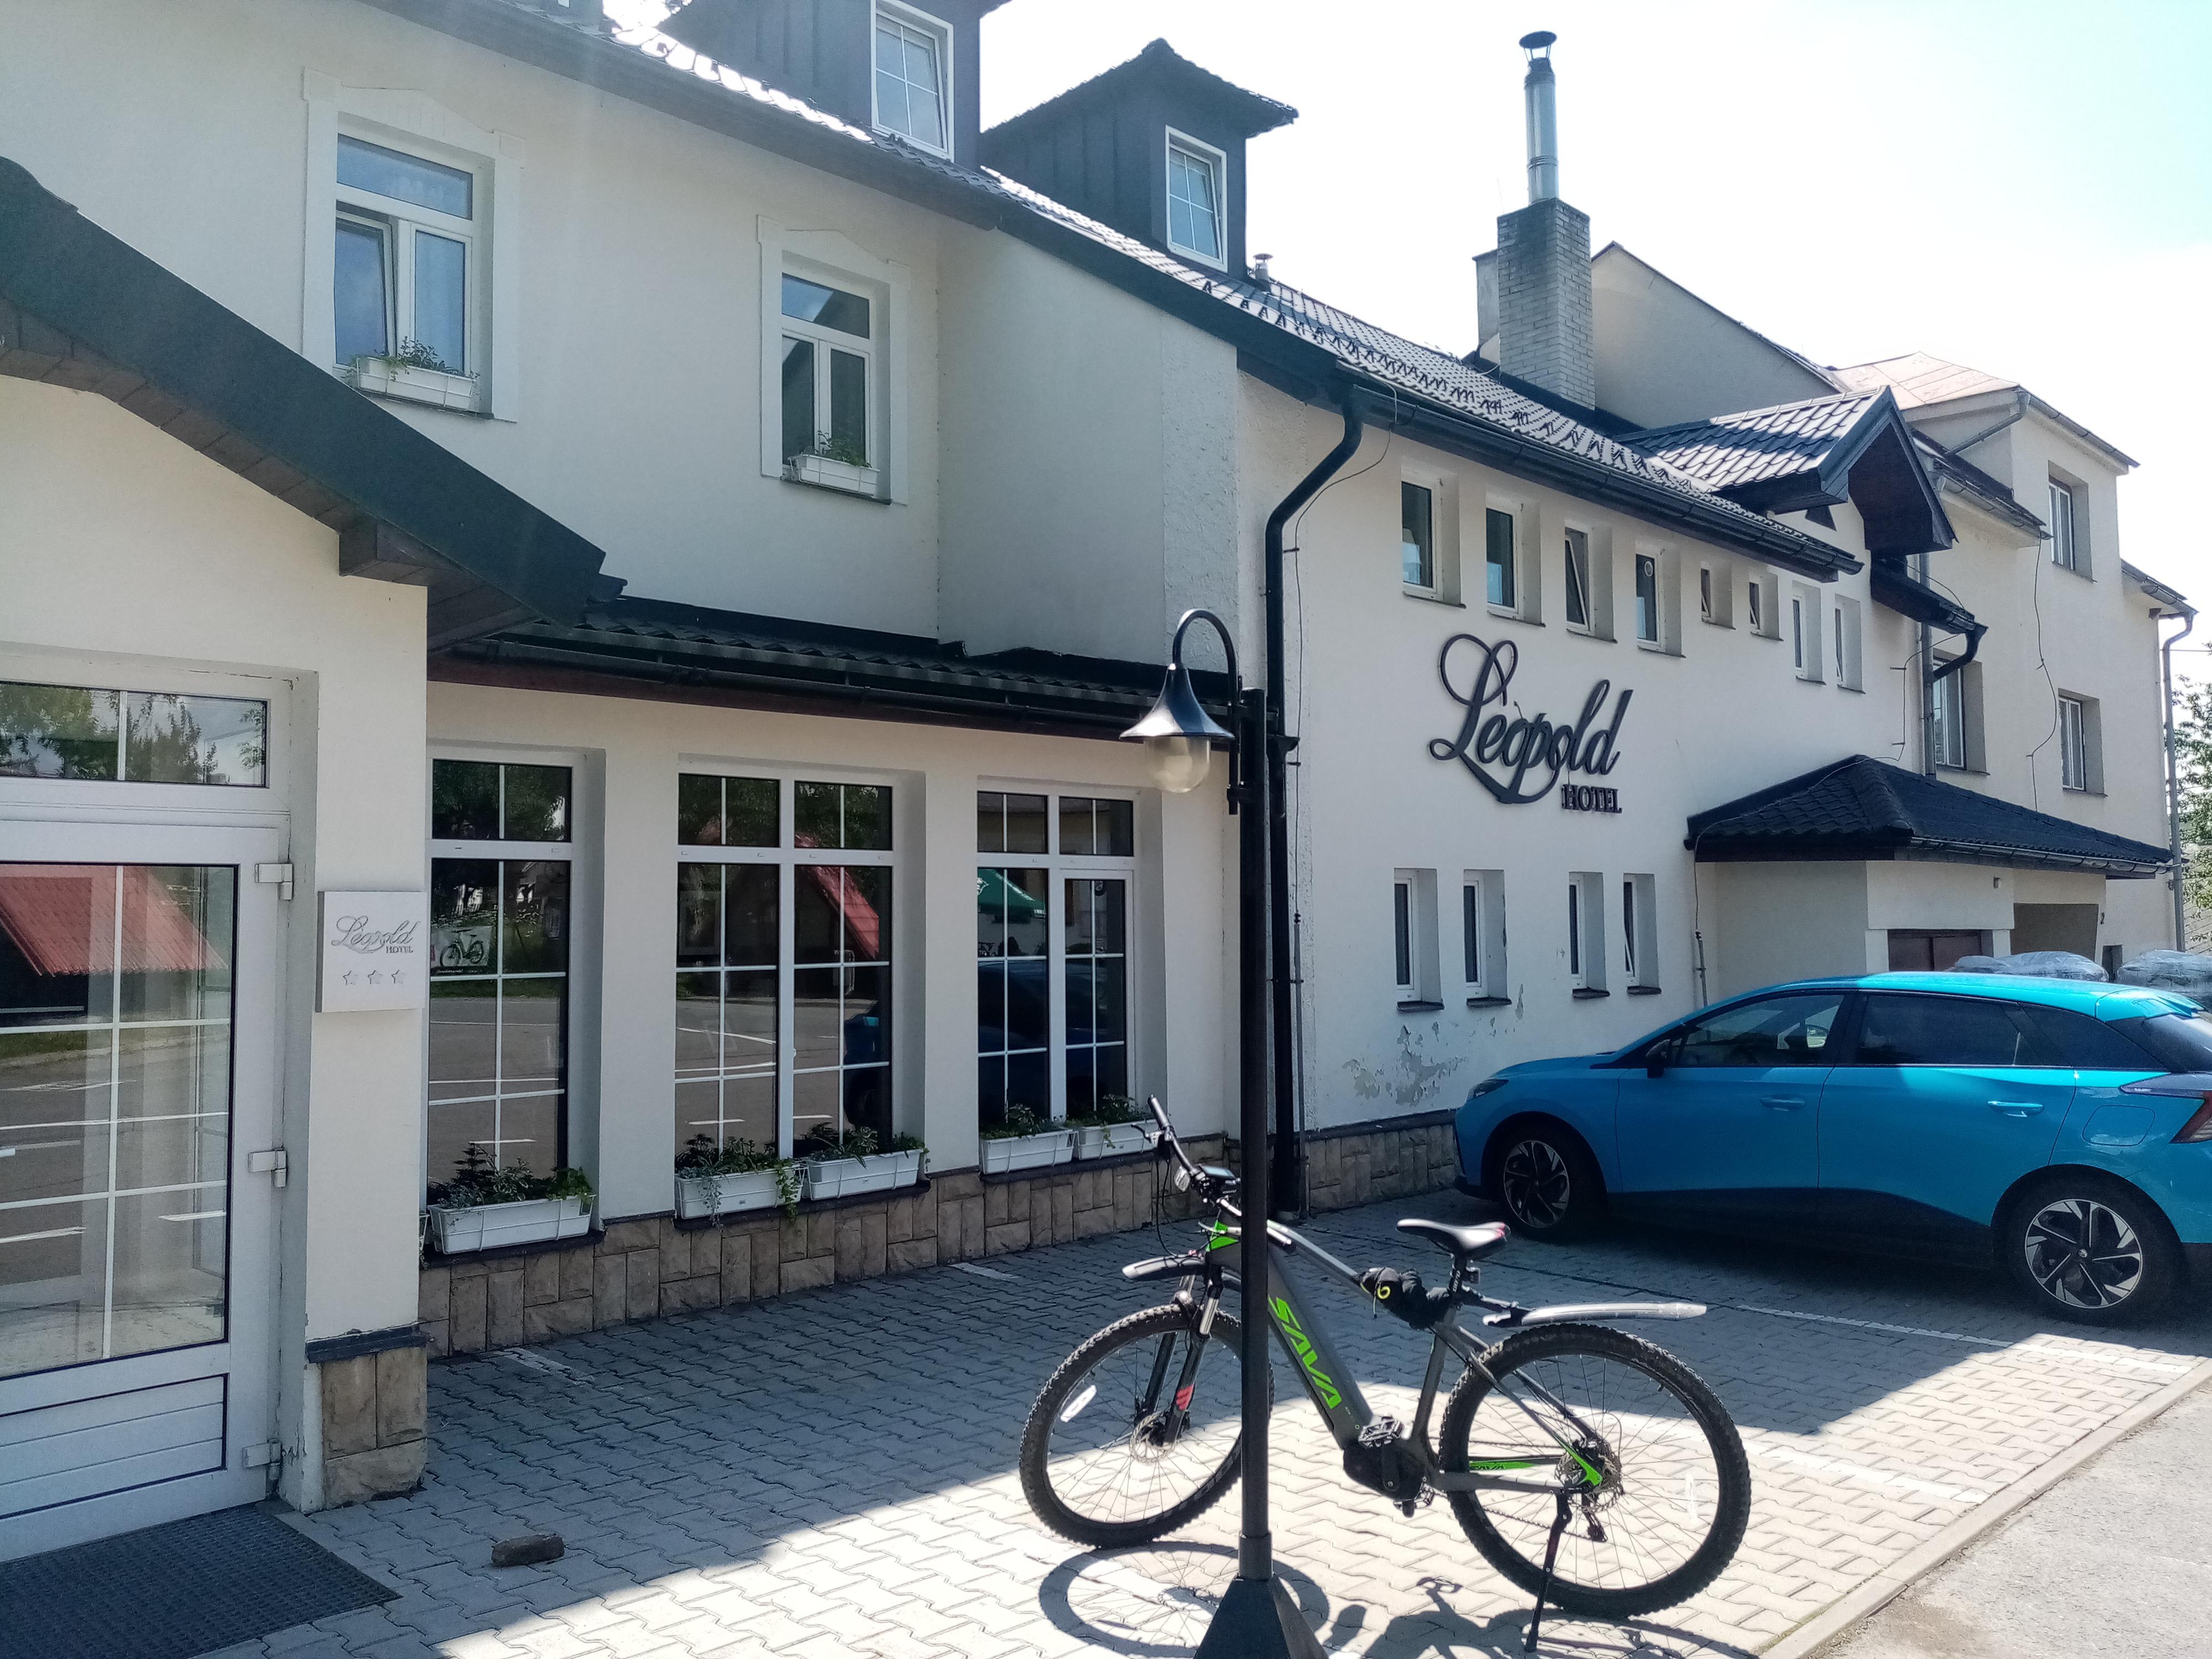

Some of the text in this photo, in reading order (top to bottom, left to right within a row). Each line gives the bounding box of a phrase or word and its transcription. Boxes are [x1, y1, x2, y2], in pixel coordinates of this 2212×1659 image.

[1429, 633, 1634, 804] Leopold
[1562, 784, 1623, 813] HOTEL
[331, 915, 421, 954] Leopold
[1267, 1294, 1342, 1409] SAVA
